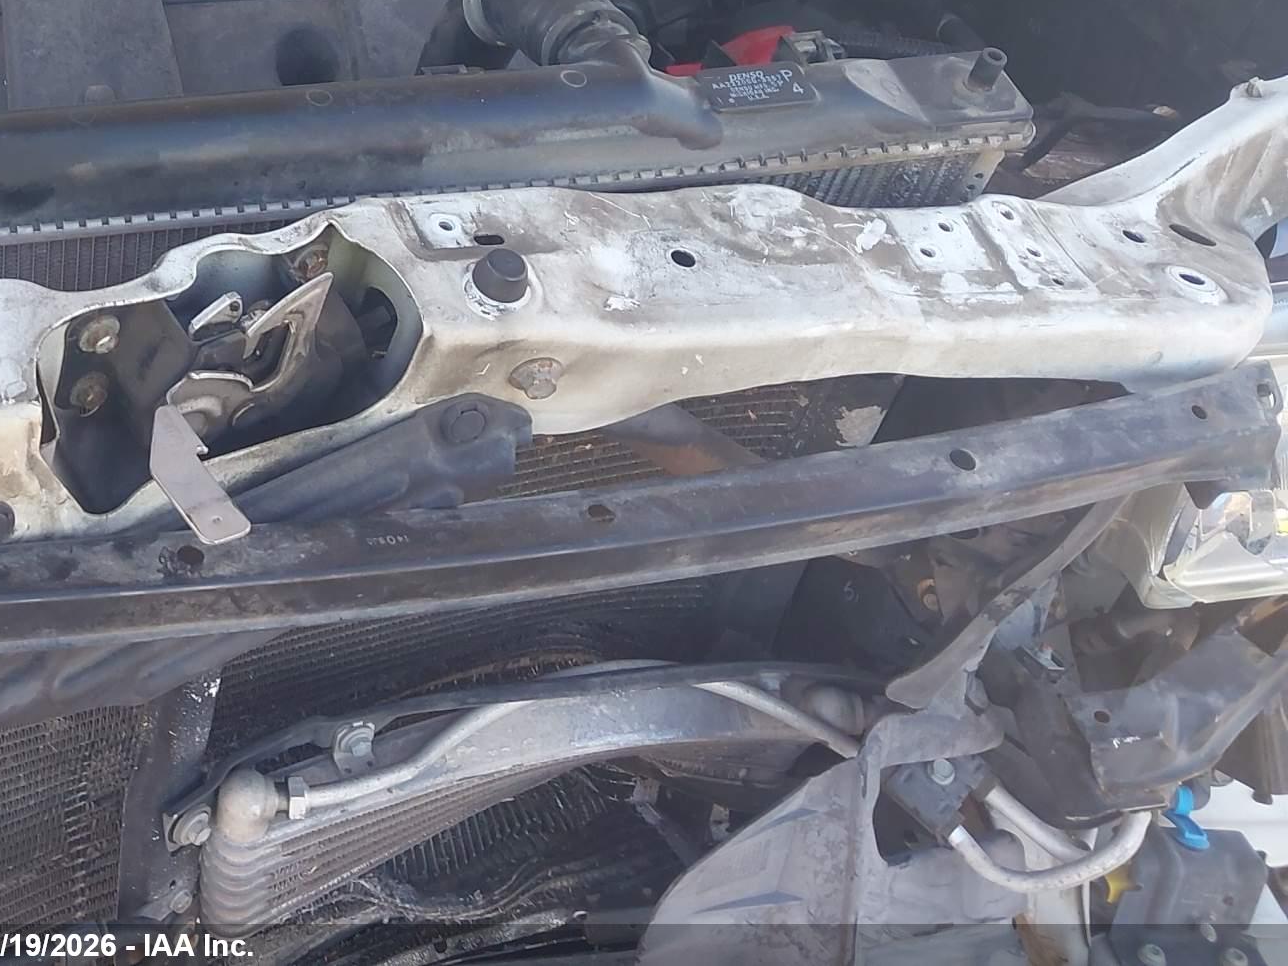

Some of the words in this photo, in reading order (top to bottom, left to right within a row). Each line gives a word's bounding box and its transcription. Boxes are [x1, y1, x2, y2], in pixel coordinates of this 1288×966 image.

[728, 70, 764, 83] DENSO
[779, 69, 793, 83] P
[793, 82, 804, 94] 4
